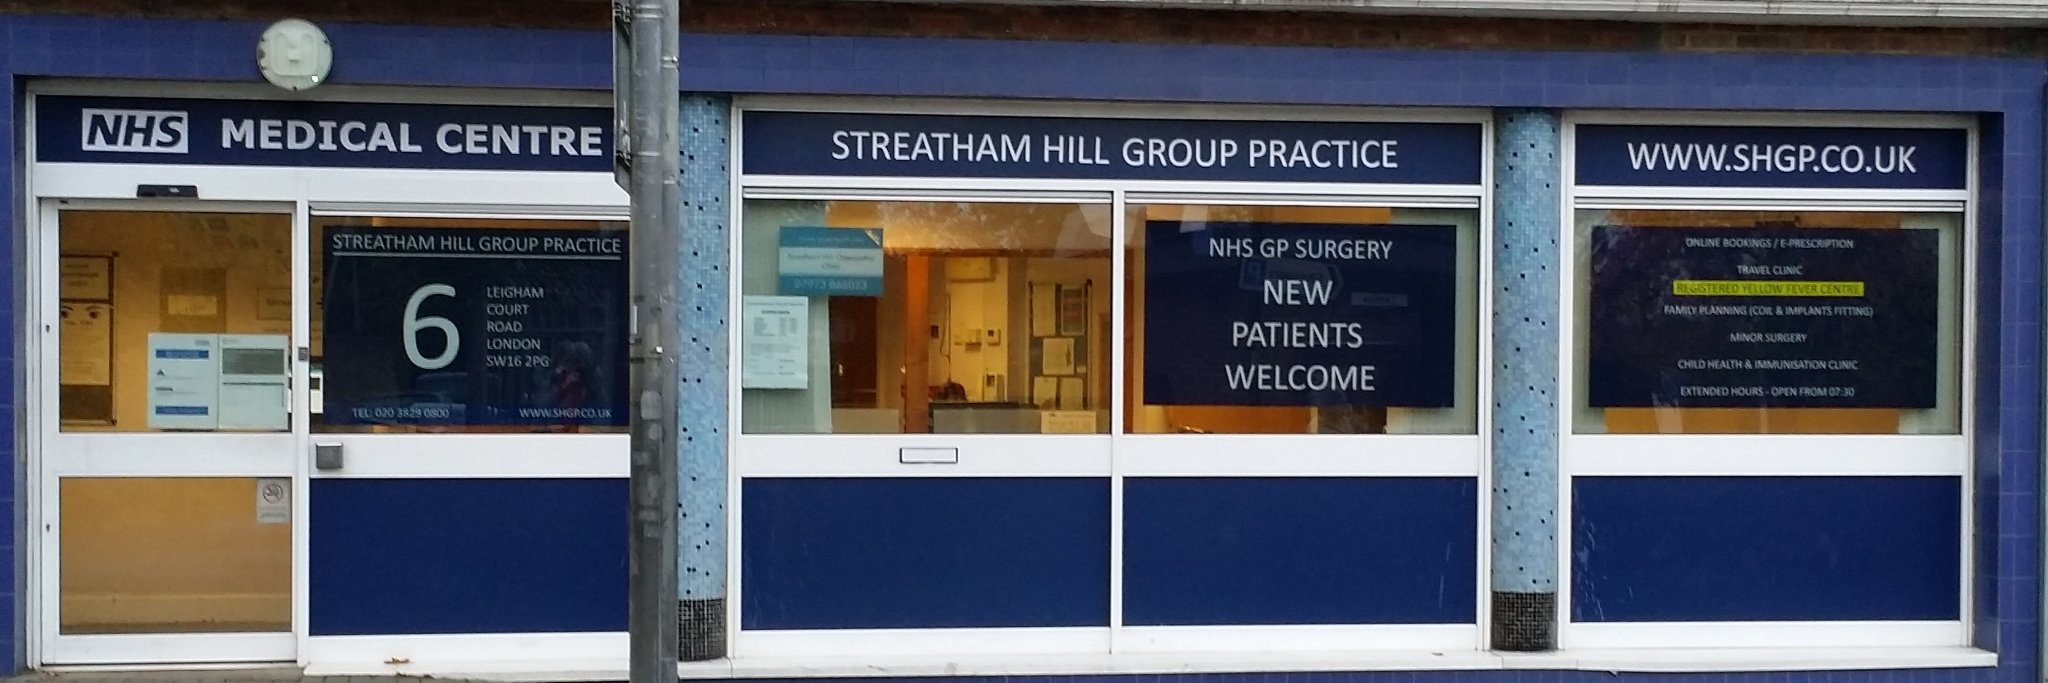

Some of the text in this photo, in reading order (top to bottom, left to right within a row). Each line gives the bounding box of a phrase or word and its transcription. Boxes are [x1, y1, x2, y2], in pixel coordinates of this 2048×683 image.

[85, 112, 184, 148] NHS
[222, 119, 602, 155] MEDICAL CENTRE
[832, 131, 1397, 168] STREATHAM HILL GROUP PRACTICE
[1628, 143, 1916, 172] WWW.SHGP.CO.UK
[333, 234, 620, 253] STREATHAM HILL GROUP PRACTICE
[1210, 238, 1392, 259] NHS GP SURGERY
[1686, 238, 1720, 247] ONLINE
[1723, 238, 1771, 247] BOOKINGS
[1780, 239, 1853, 248] E-PRESCRIPTION
[1738, 265, 1802, 275] TRAVEL CLINIC
[487, 286, 543, 298] LEIGHAM
[1264, 280, 1332, 305] NEW
[1676, 284, 1860, 297] REGISTERED YELLOW FEVER CENTRE
[487, 304, 529, 315] COURT
[1664, 305, 1873, 317] FAMILY PLANNING (COIL & IMPLANTS FITTING)
[403, 284, 459, 369] 6
[487, 321, 522, 332] ROAD
[1233, 322, 1362, 348] PATIENTS
[1731, 333, 1807, 342] MINOR SURGERY
[487, 339, 540, 349] LONDON
[487, 356, 549, 367] SW16 2PG
[1678, 359, 1858, 369] CHILD HEALTH & IMMUNISATION CLINIC
[1225, 365, 1374, 390] WELCOME
[1681, 386, 1729, 396] EXTENDED
[1731, 387, 1763, 396] HOURS
[1771, 387, 1797, 396] OPEN
[1799, 387, 1827, 396] FROM
[1829, 387, 1854, 396] 07:30
[352, 405, 373, 419] TEL:
[374, 406, 395, 419] 020
[519, 406, 613, 420] WWW.SHGP.CO.UK
